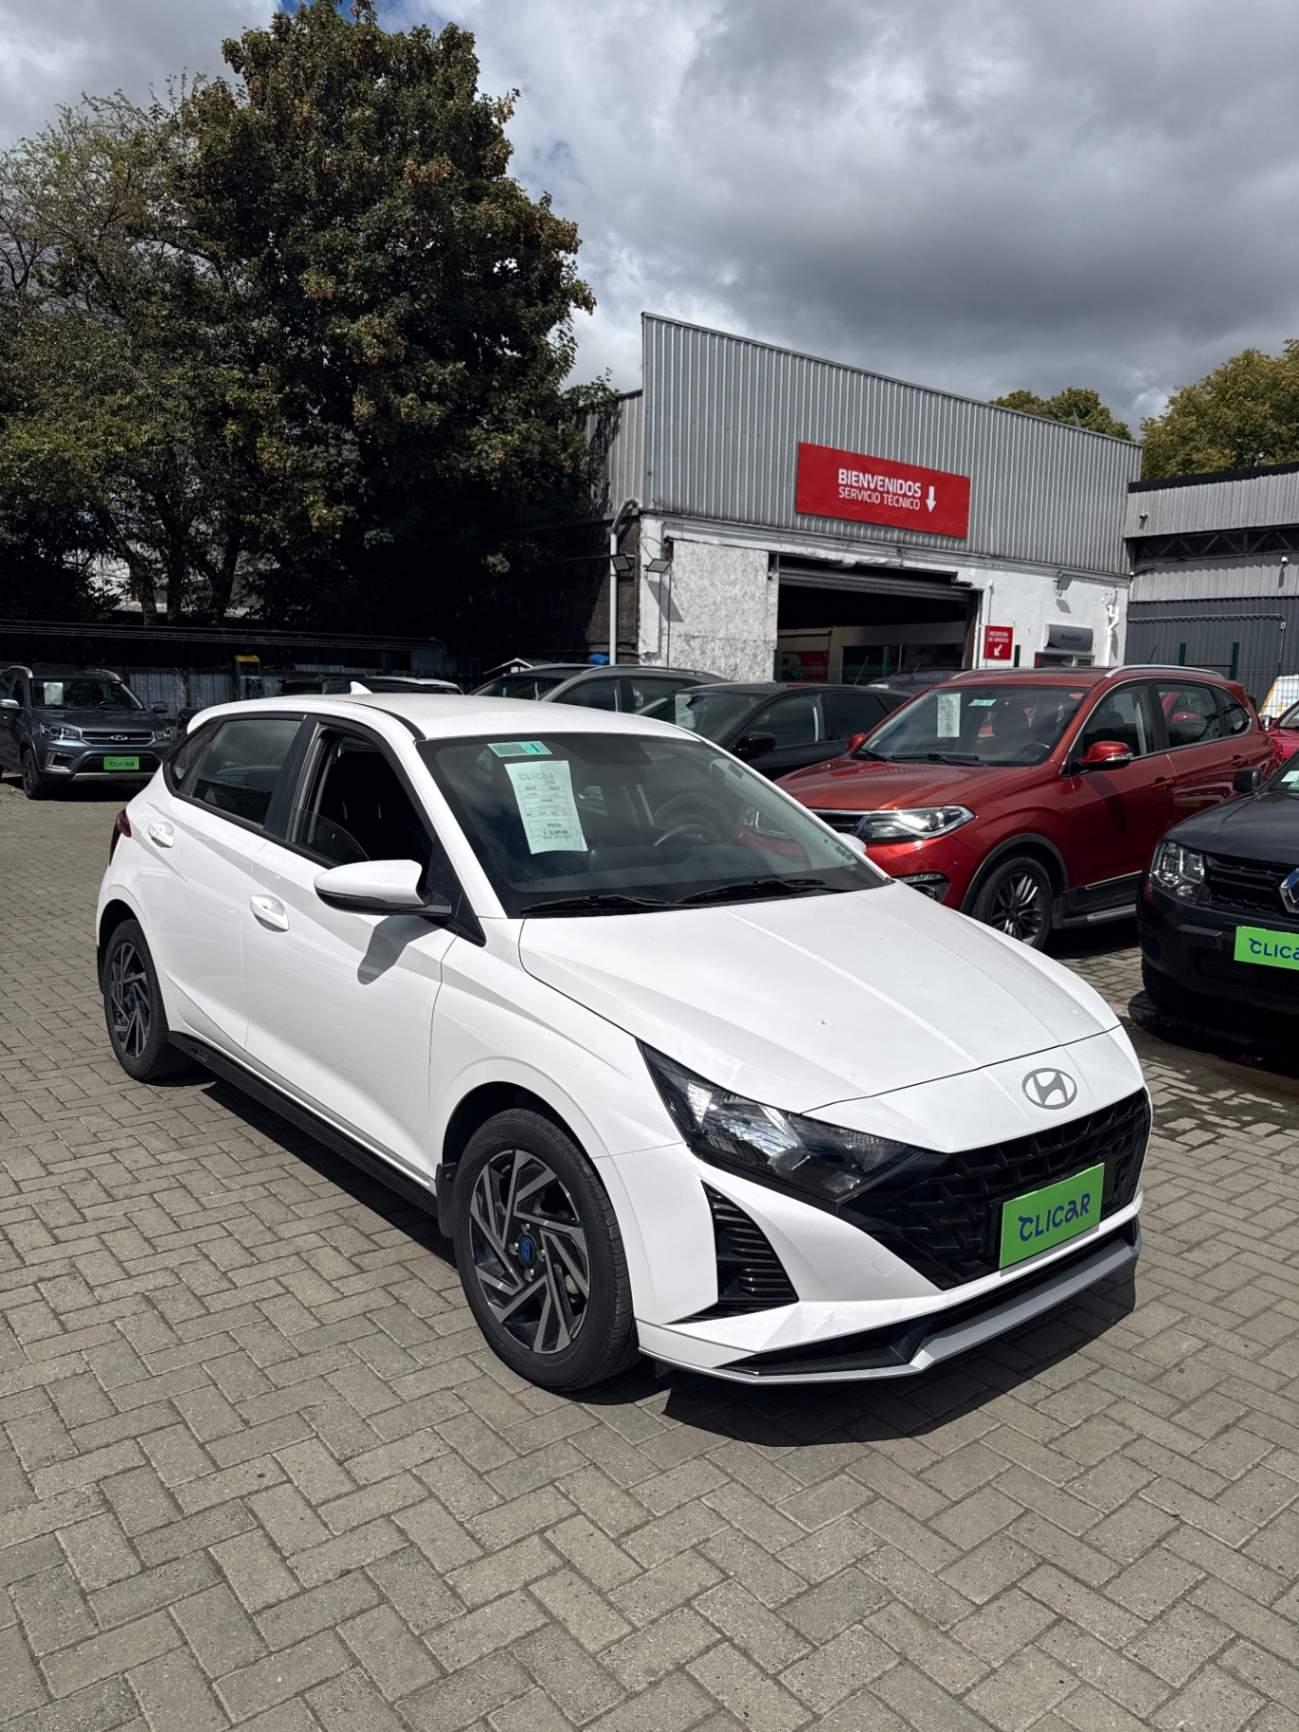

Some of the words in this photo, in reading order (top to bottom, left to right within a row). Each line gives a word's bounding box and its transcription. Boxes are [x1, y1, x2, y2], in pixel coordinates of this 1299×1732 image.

[838, 468, 922, 497] BIENVENIDOS
[838, 486, 880, 504] SERVICIO
[883, 492, 920, 511] TÉCNICO
